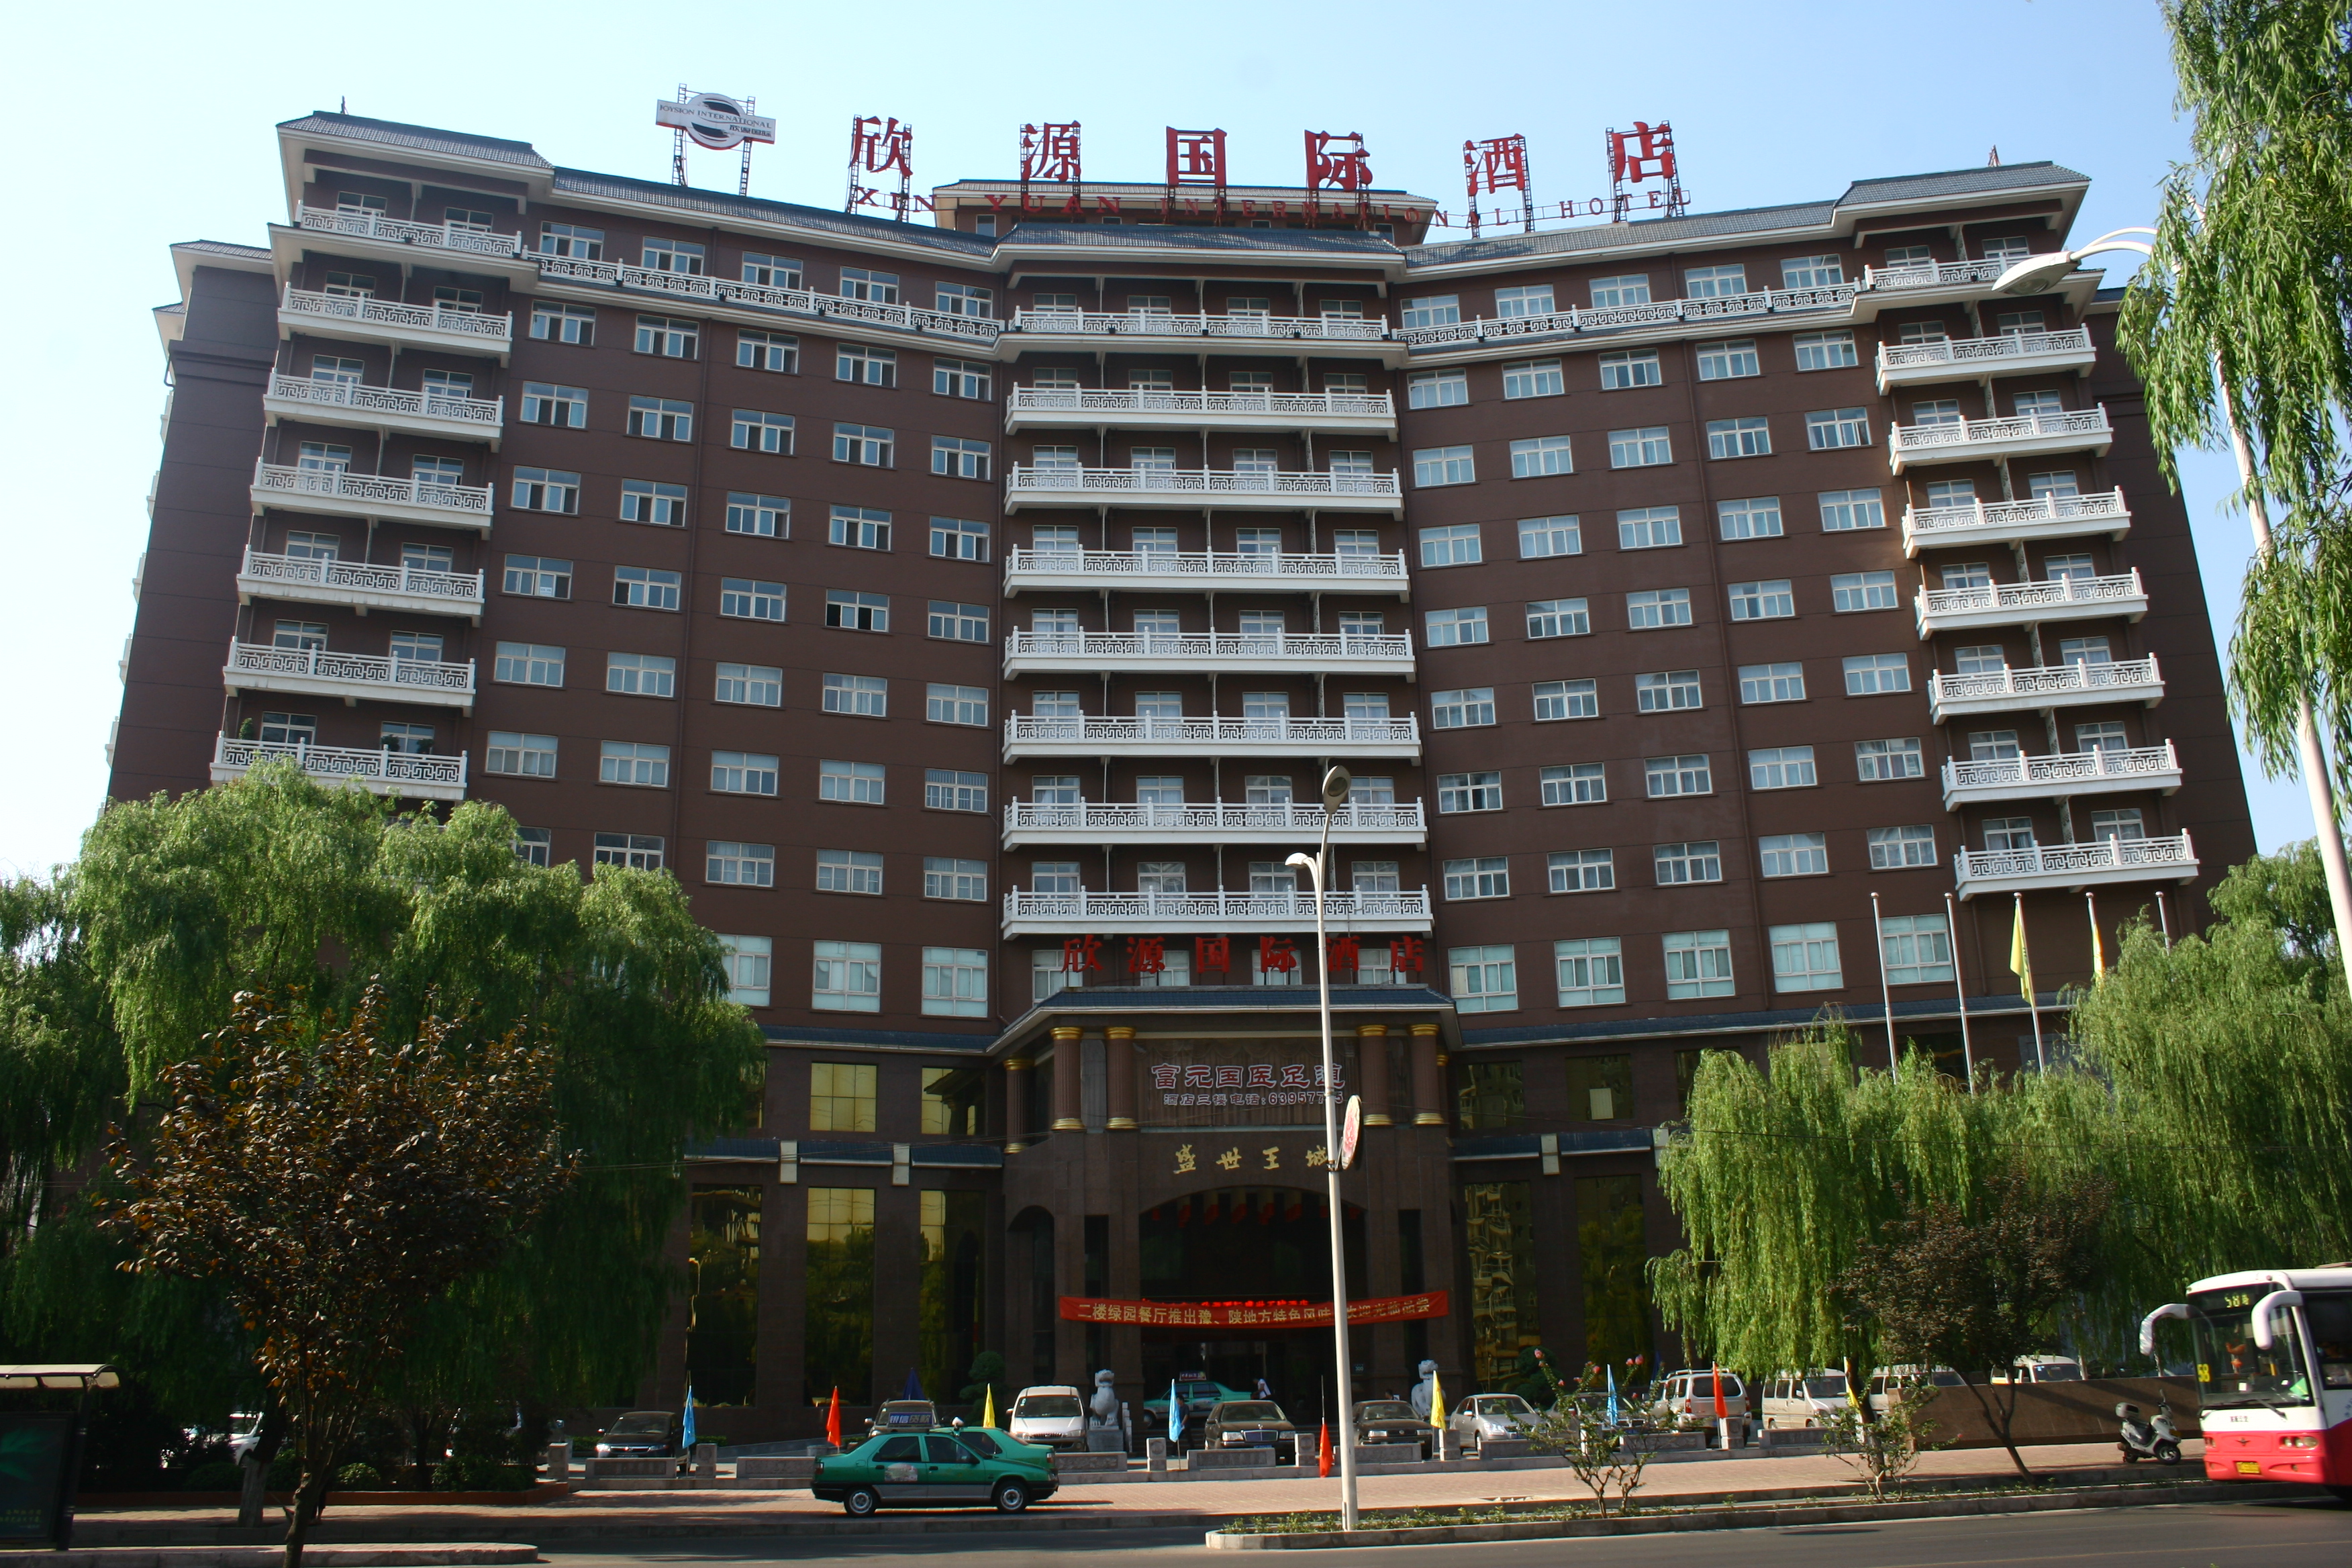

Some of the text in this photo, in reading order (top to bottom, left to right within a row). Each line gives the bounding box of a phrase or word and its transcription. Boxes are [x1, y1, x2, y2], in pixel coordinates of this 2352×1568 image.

[660, 104, 772, 129] JOYSION INTERNATIONAL
[848, 116, 1674, 196] 欣源国际酒店
[856, 187, 1691, 228] XIN YUAN INTERNATIONAL HOTEL
[1061, 934, 1424, 974] 欣源国际酒店
[1151, 1063, 1345, 1089] 富元国医足道
[1173, 1144, 1328, 1175] 盛世王城
